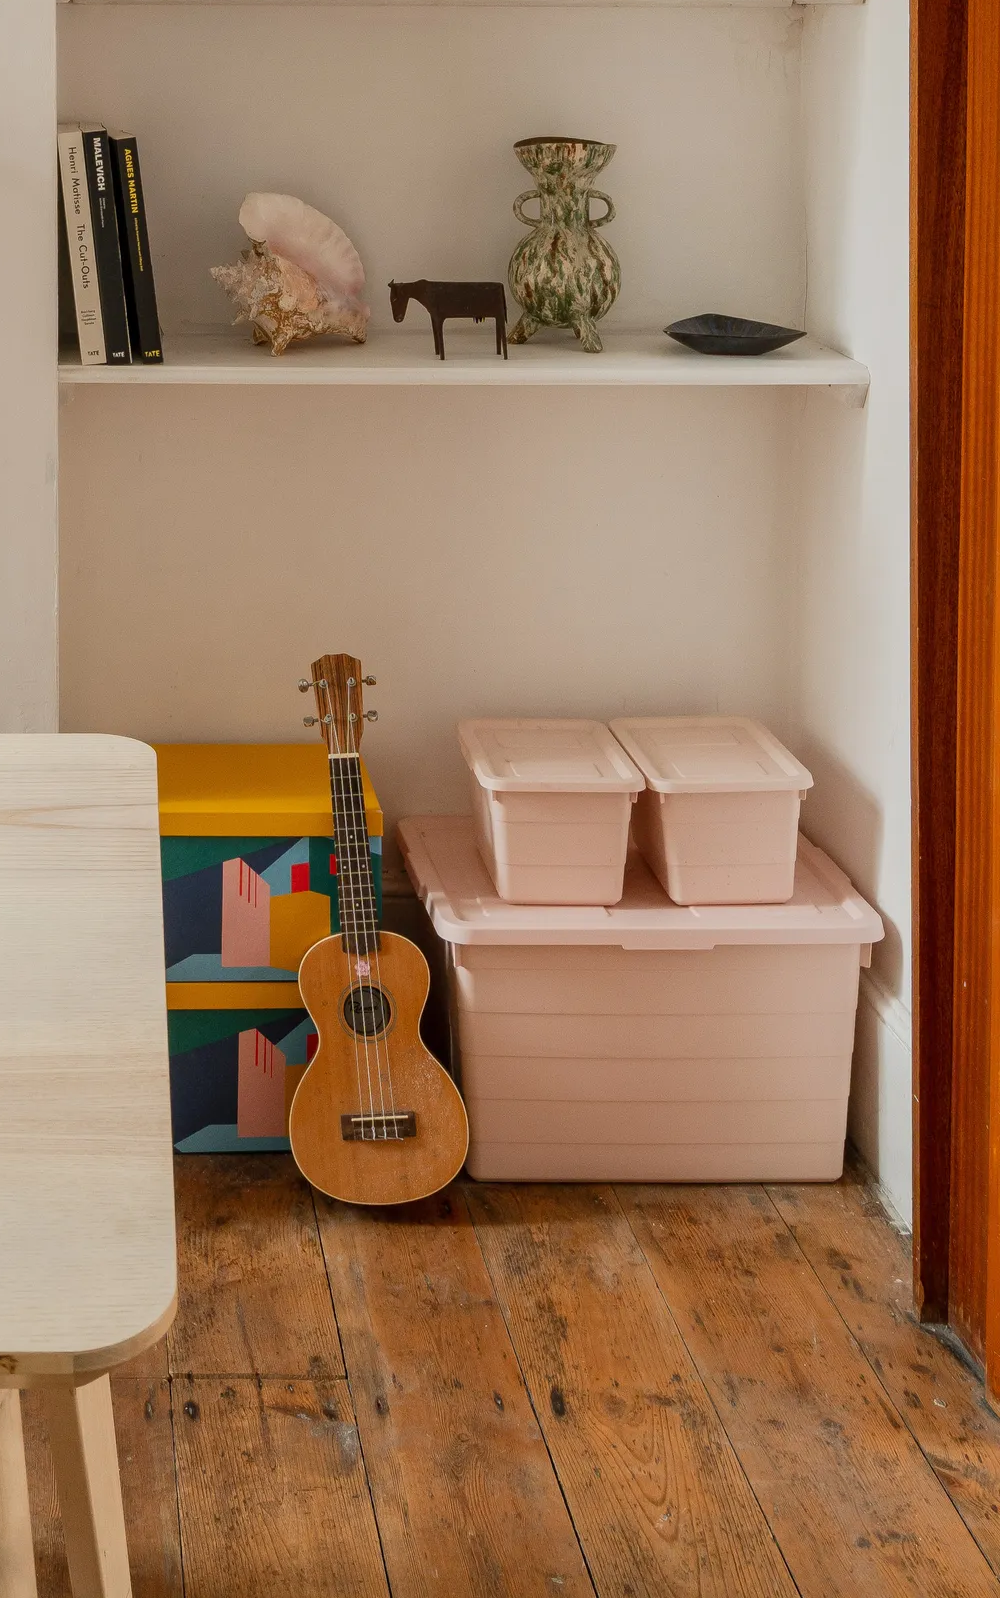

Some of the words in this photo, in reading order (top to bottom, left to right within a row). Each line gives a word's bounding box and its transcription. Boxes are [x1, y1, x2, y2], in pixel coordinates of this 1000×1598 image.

[68, 147, 79, 174] Henri
[92, 137, 106, 191] MALEVICH
[124, 148, 135, 178] AGNES
[71, 177, 83, 215] Matisse
[128, 180, 139, 213] MARTIN
[76, 224, 87, 241] The
[78, 244, 90, 289] Cut-Outs
